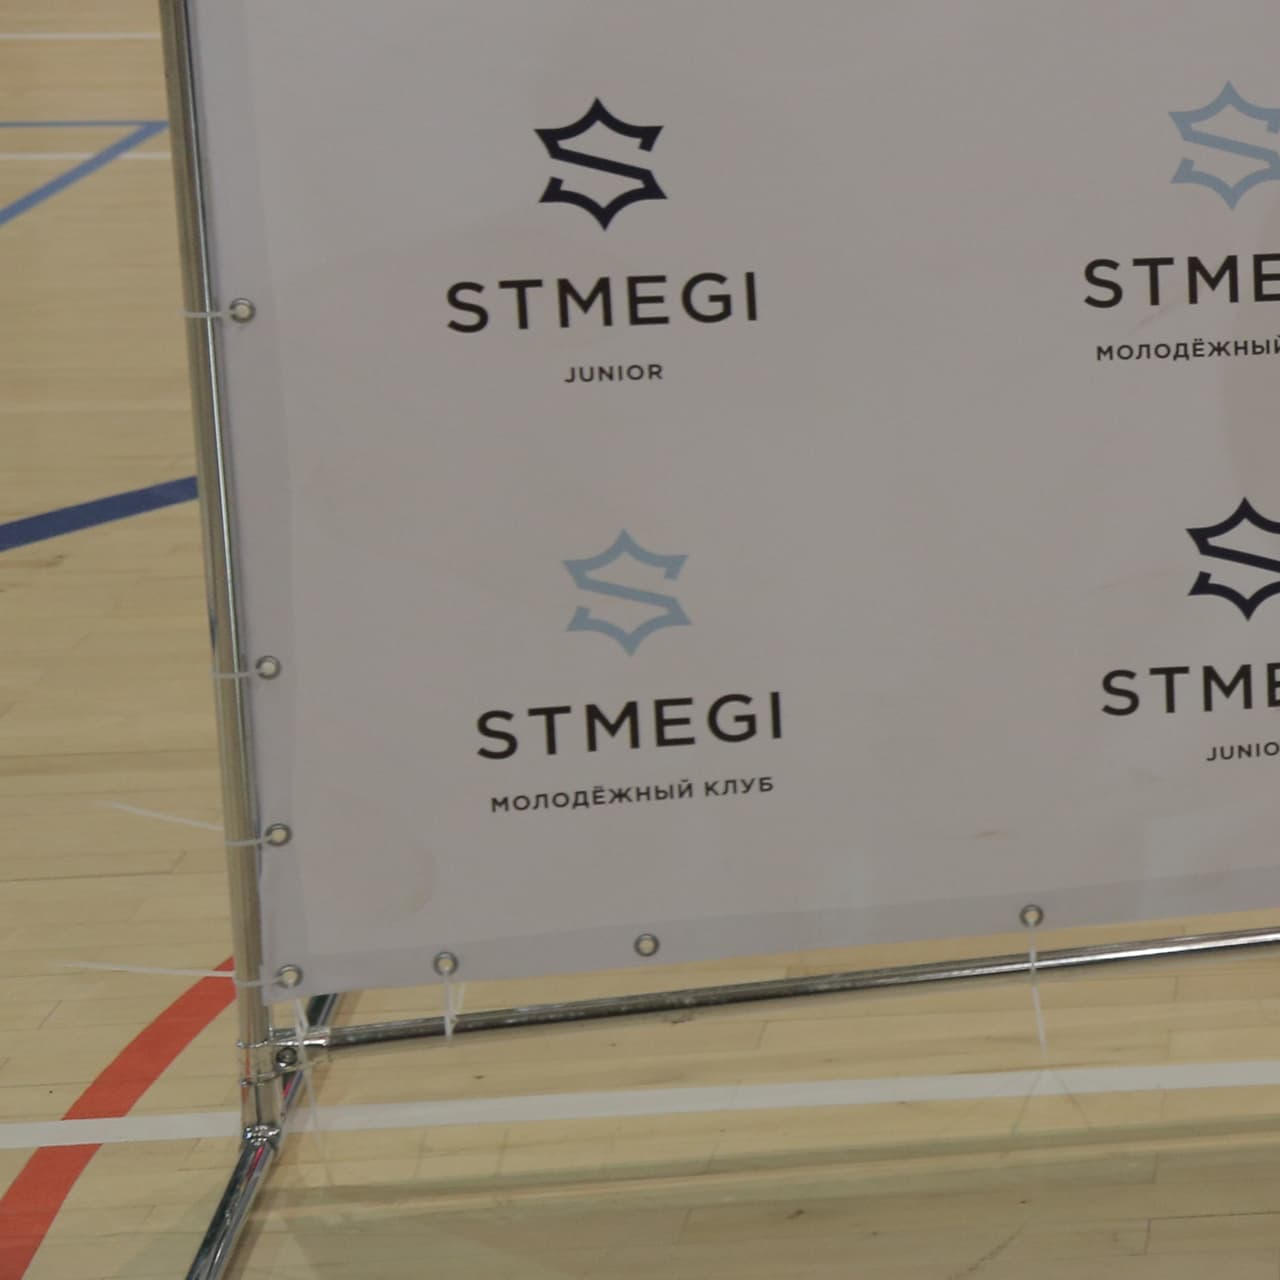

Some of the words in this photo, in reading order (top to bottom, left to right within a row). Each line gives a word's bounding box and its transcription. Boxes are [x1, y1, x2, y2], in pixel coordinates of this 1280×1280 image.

[446, 271, 758, 334] STMEGI
[564, 363, 663, 384] JUNIOR
[477, 691, 782, 760] STMEGI
[490, 779, 693, 813] МОЛОДЁЖНЫЙ
[704, 776, 774, 797] КЛУБ
